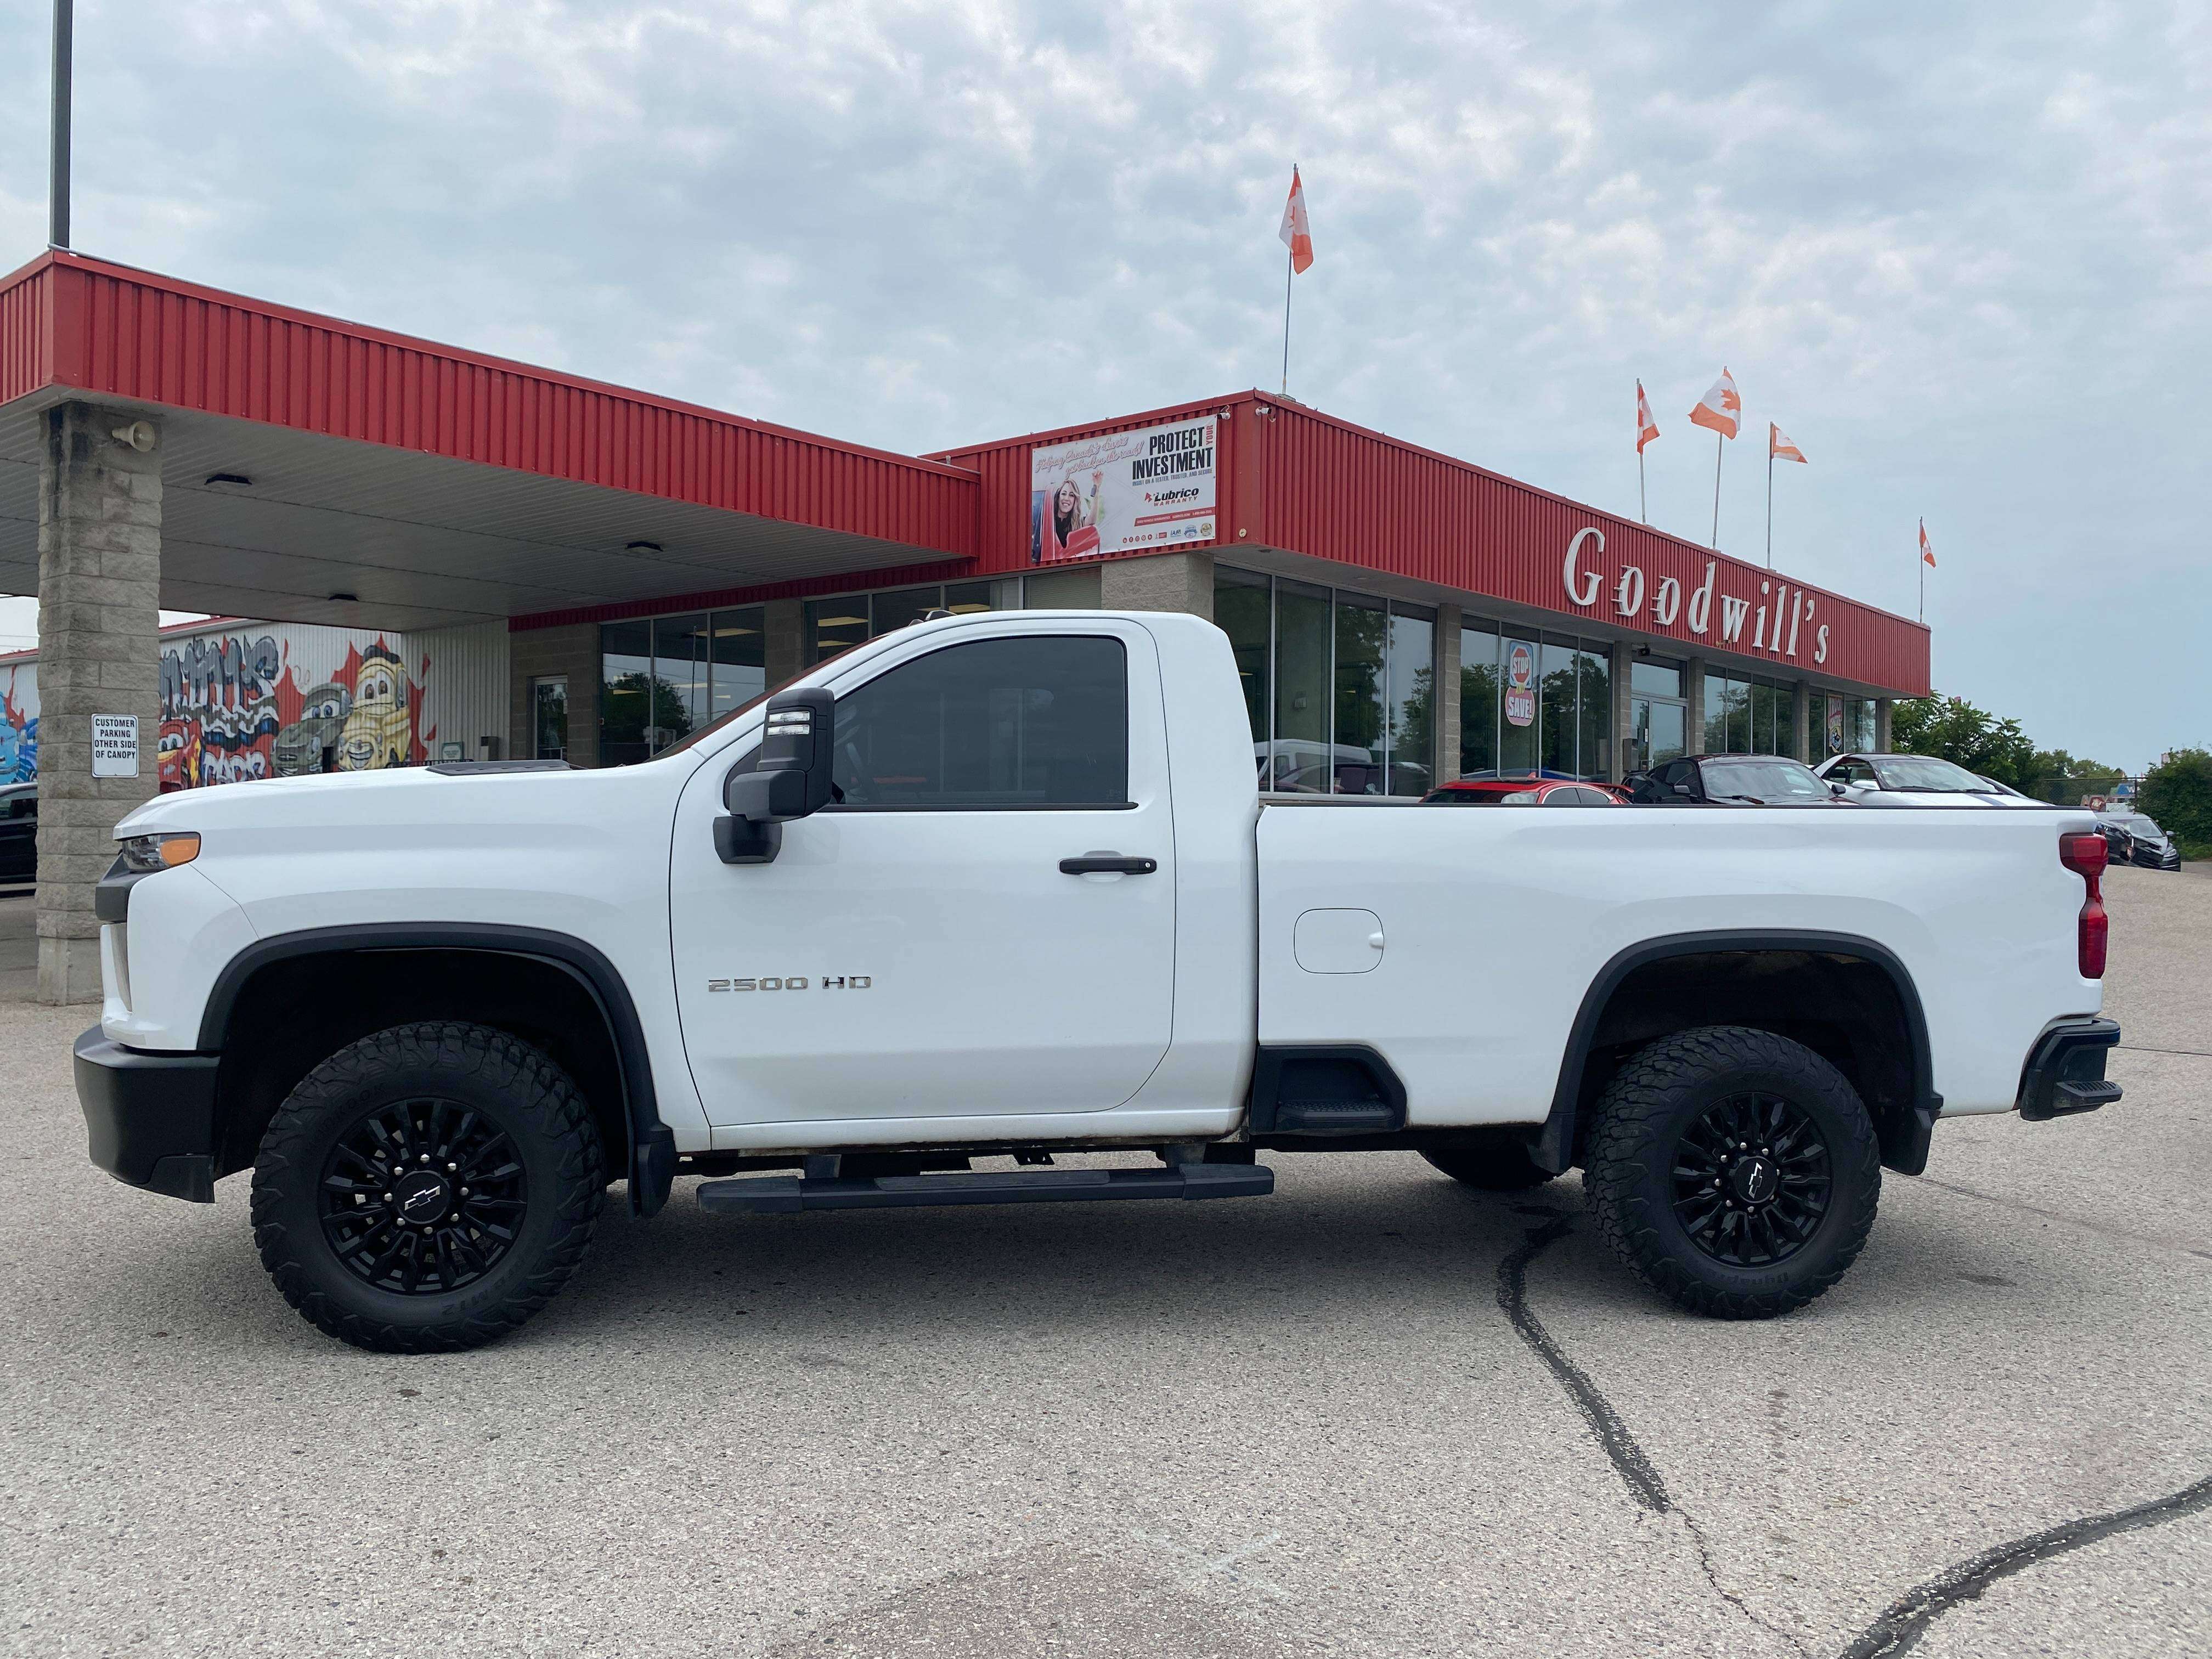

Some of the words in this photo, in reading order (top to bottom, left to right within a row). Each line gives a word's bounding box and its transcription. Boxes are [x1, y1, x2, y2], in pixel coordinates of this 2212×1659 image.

[1149, 426, 1205, 455] PROTECT
[1035, 455, 1065, 473] Helping
[1065, 442, 1101, 462] Canada's
[1132, 447, 1213, 480] INVESTMENT
[1154, 488, 1199, 502] Lubrico
[1154, 495, 1198, 506] WARRANTY
[1564, 527, 1829, 664] Goodwill's
[1513, 657, 1530, 674] STOP
[1515, 685, 1525, 695] AND
[1509, 696, 1532, 720] SAVE!
[95, 719, 135, 727] CUSTOMER
[100, 729, 131, 737] PARKING
[95, 740, 118, 748] OTHER
[95, 750, 104, 758] OF
[107, 751, 136, 759] CANOPY
[708, 977, 808, 992] 2500
[822, 975, 871, 989] HD
